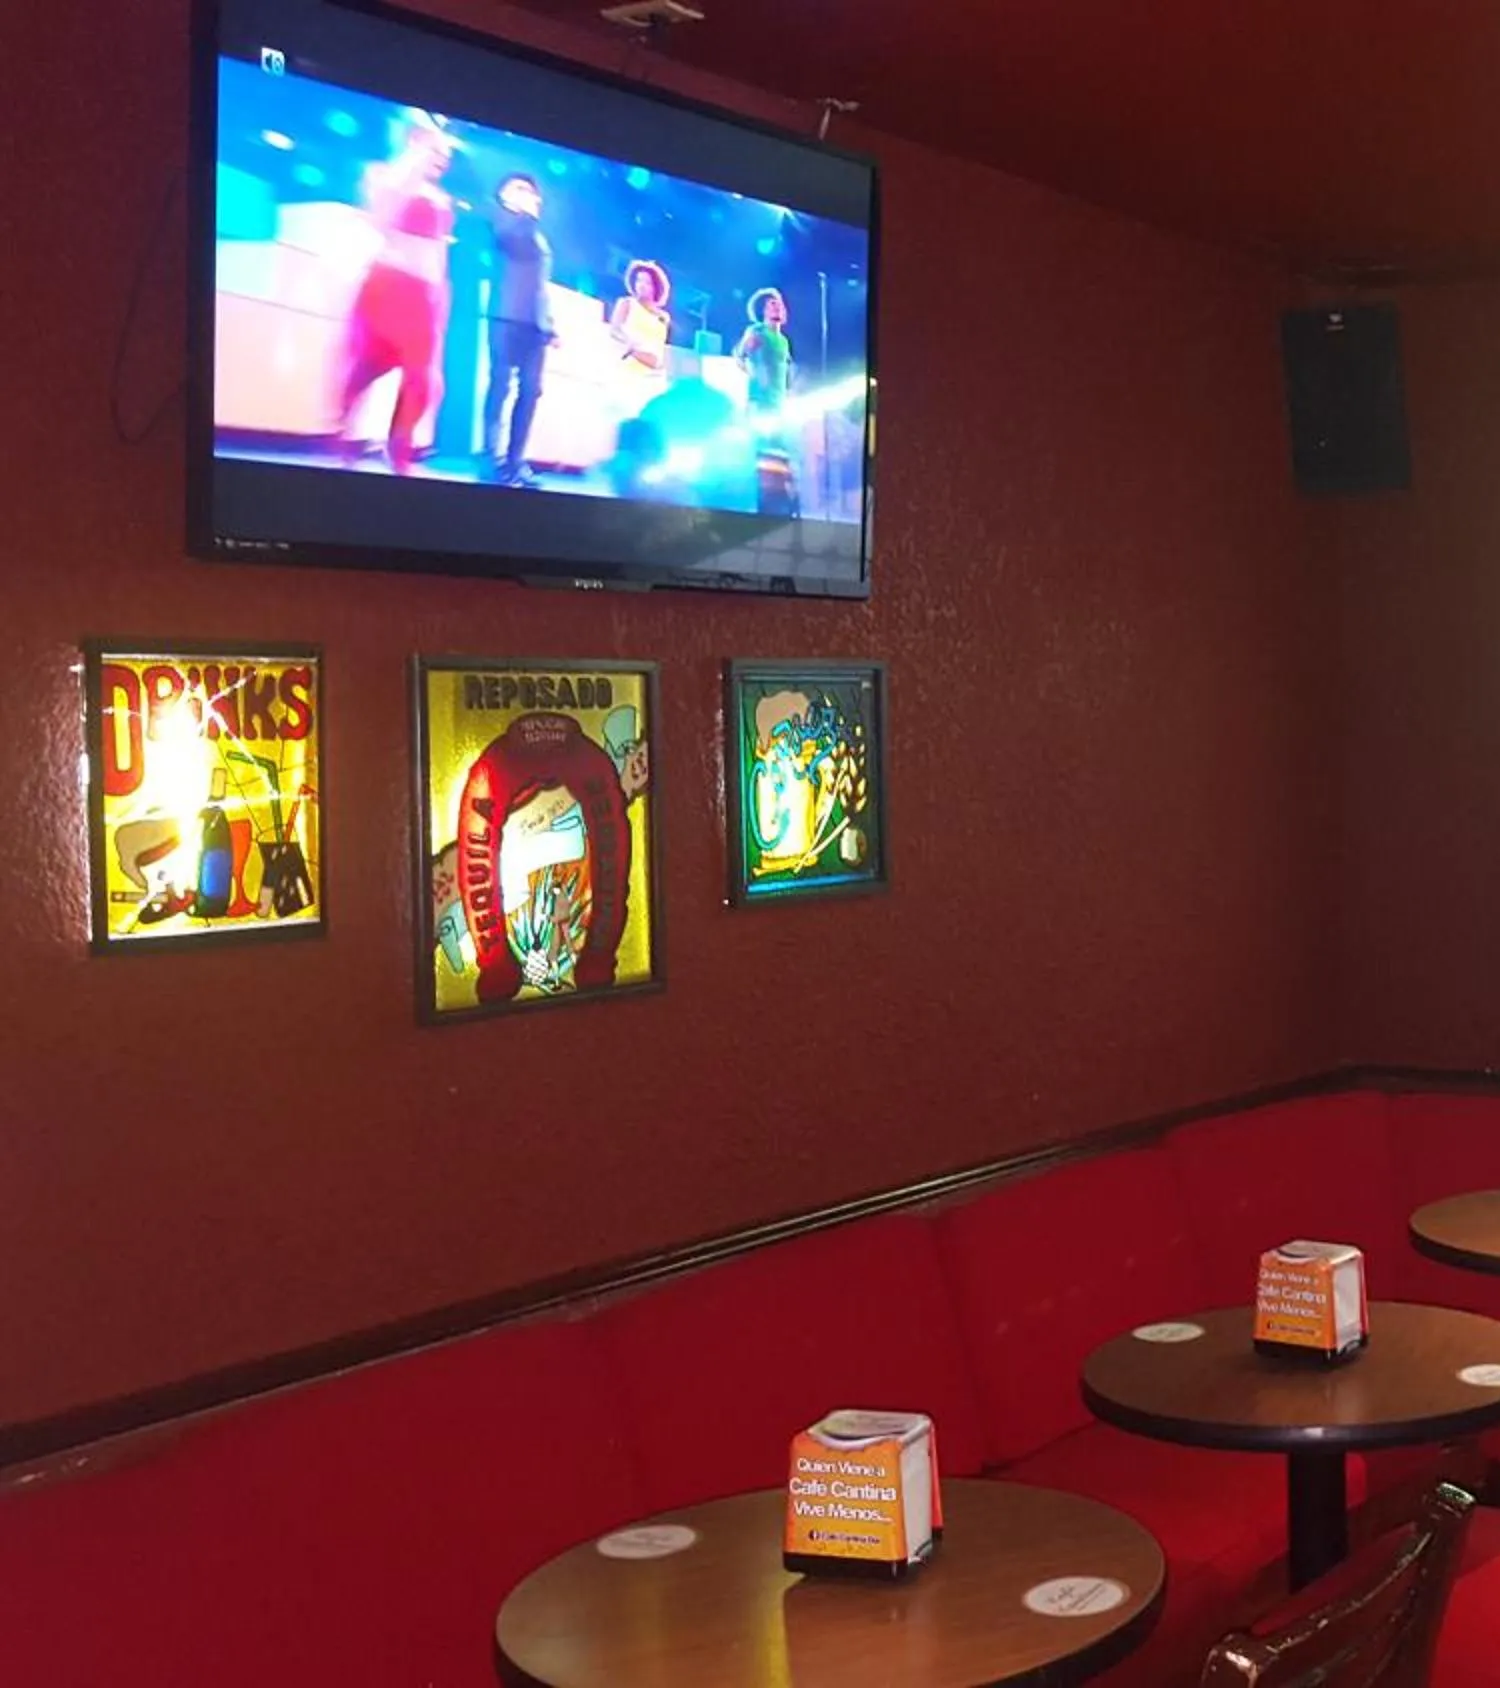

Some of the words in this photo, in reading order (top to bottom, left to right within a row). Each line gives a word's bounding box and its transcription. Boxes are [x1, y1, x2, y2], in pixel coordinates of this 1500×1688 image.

[464, 675, 613, 709] REPOSADO
[466, 797, 499, 953] TEQUILA
[797, 1458, 835, 1474] Quien
[838, 1461, 874, 1476] Viene
[831, 1480, 897, 1501] Cantina
[793, 1501, 825, 1517] Vive
